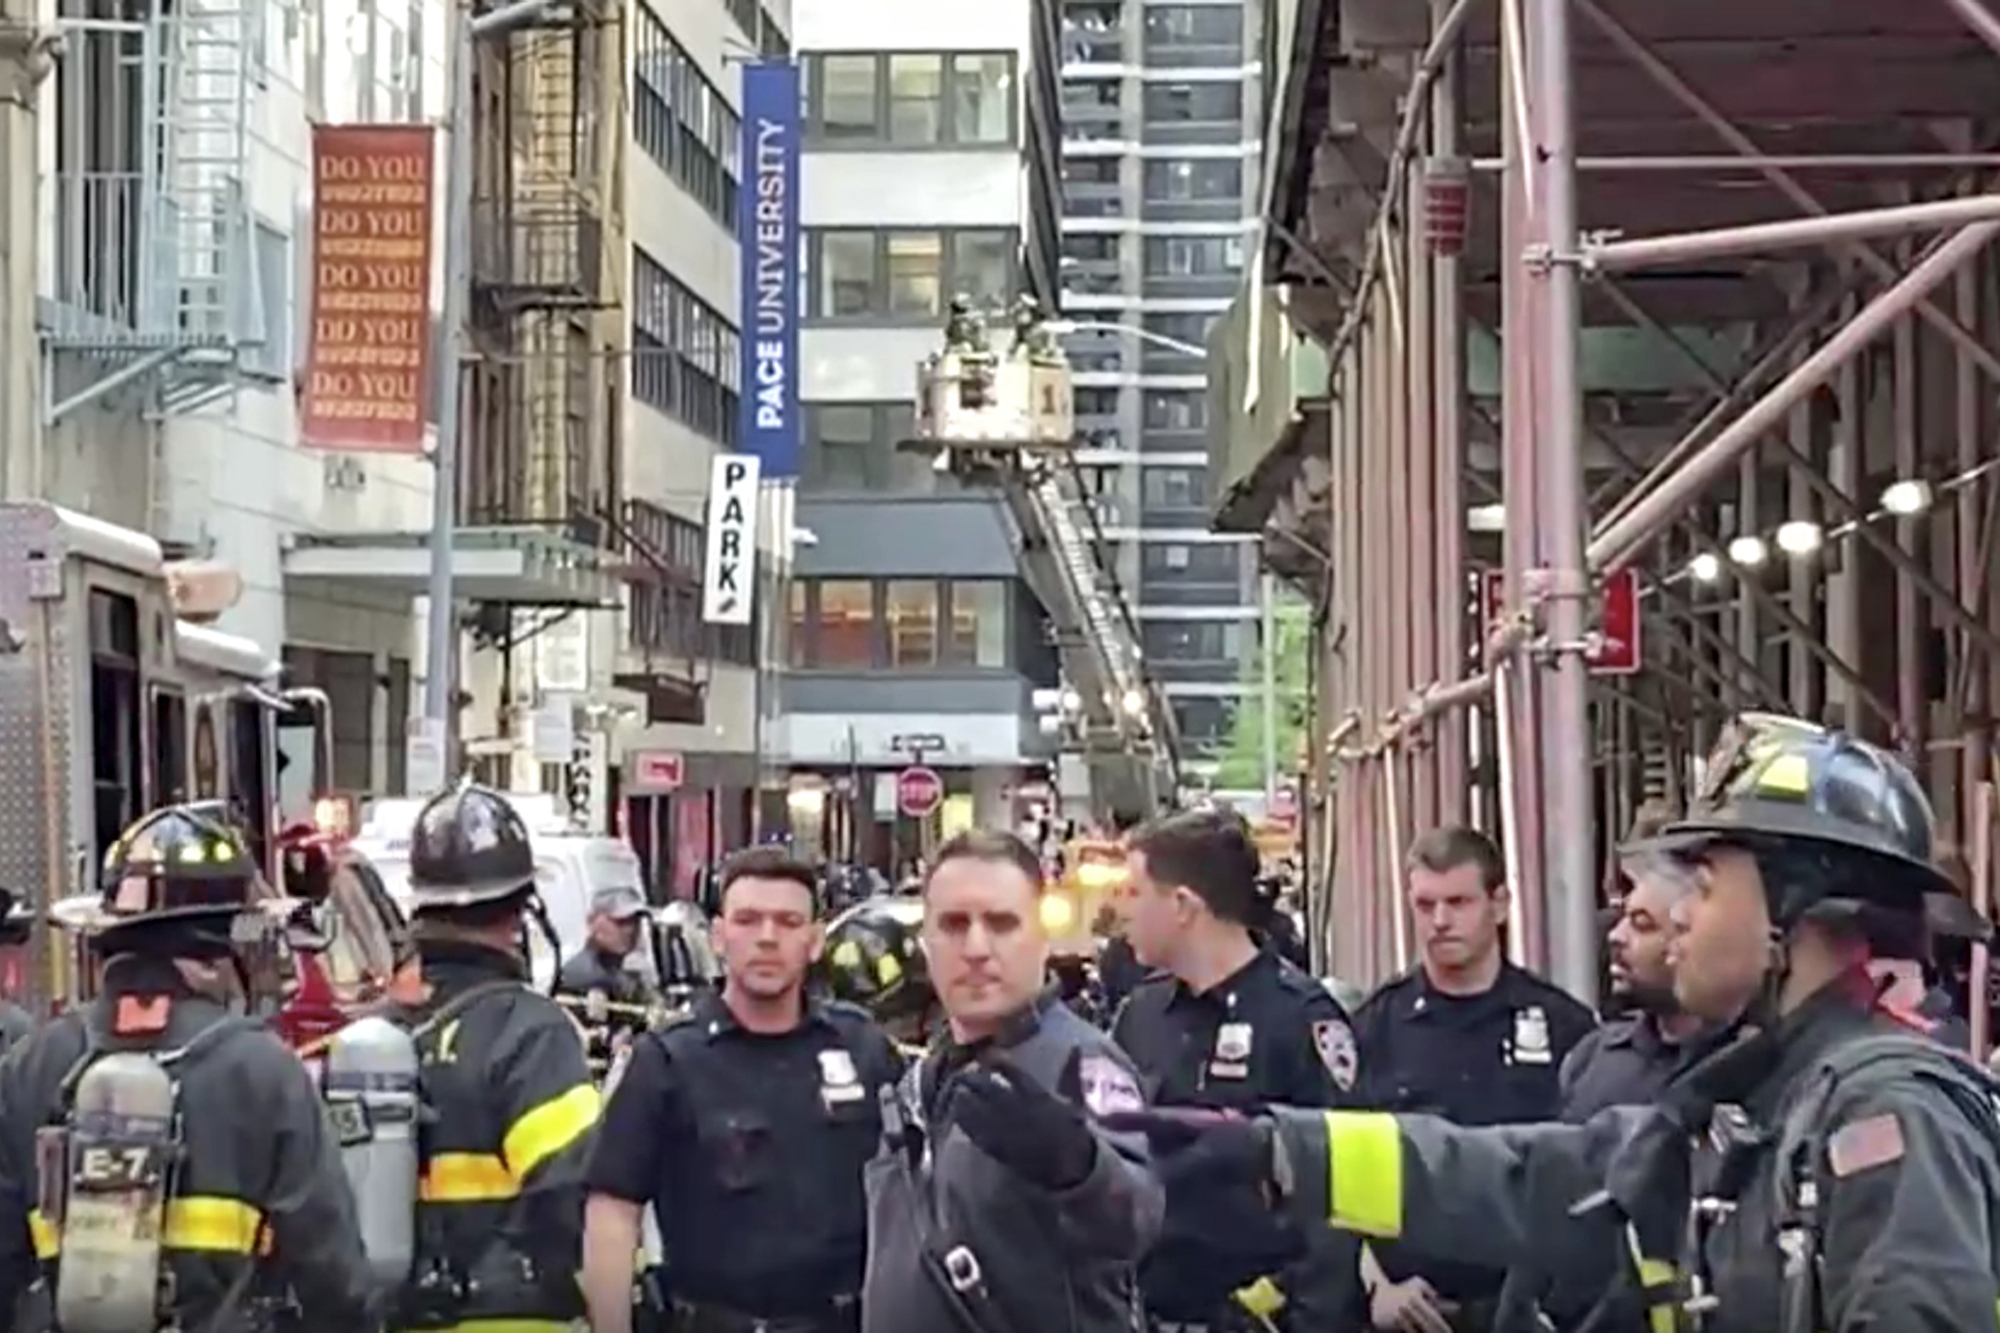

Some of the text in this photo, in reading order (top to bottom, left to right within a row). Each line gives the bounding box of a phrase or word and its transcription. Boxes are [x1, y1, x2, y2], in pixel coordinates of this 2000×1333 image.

[319, 155, 424, 181] DO YOU
[319, 210, 422, 236] DO YOU
[319, 264, 421, 289] DO YOU
[756, 118, 786, 429] PACE UNIVERSITY
[362, 319, 419, 344] YOU
[312, 371, 416, 399] DO YOU
[717, 461, 747, 592] PARK
[82, 1146, 151, 1180] E-7
